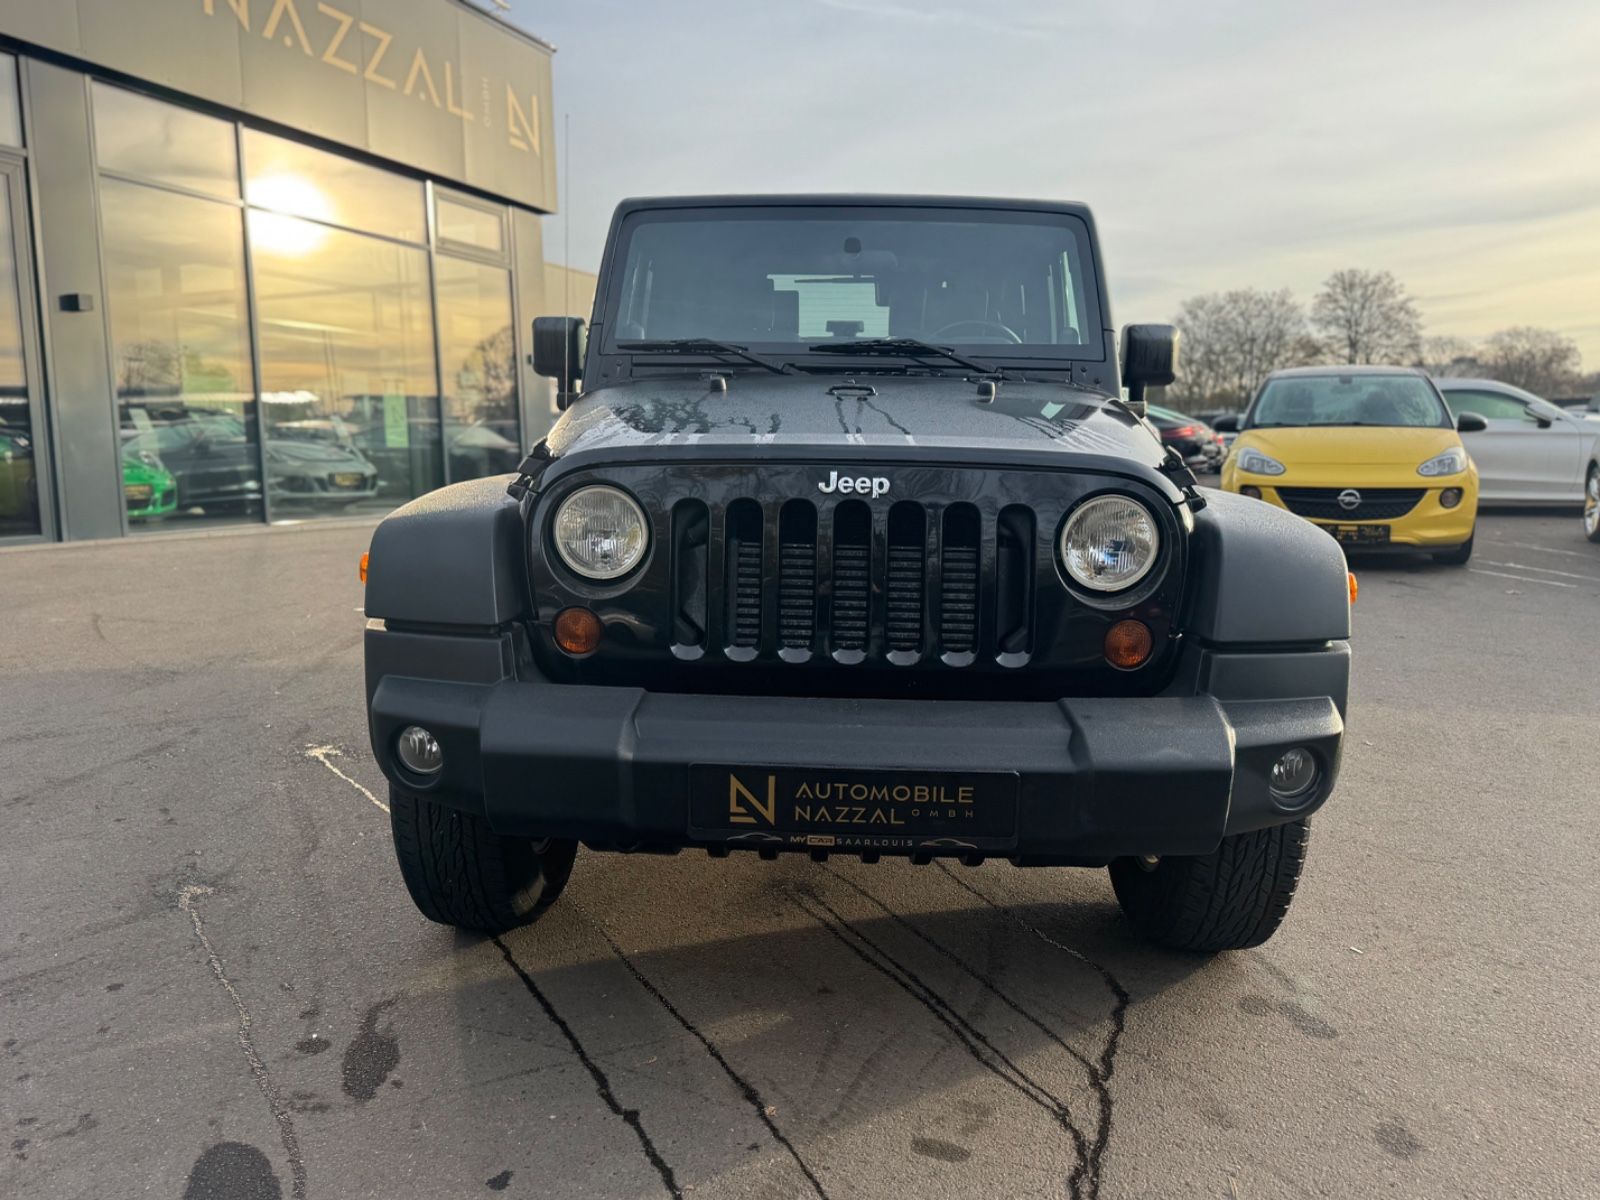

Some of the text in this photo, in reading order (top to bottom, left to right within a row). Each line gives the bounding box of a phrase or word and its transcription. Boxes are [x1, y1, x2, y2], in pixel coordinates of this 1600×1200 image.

[818, 470, 890, 499] Jeep
[795, 782, 974, 803] AUTOMOBILE
[795, 806, 905, 824] NAZZAL
[836, 837, 913, 847] SAARLOUIS
